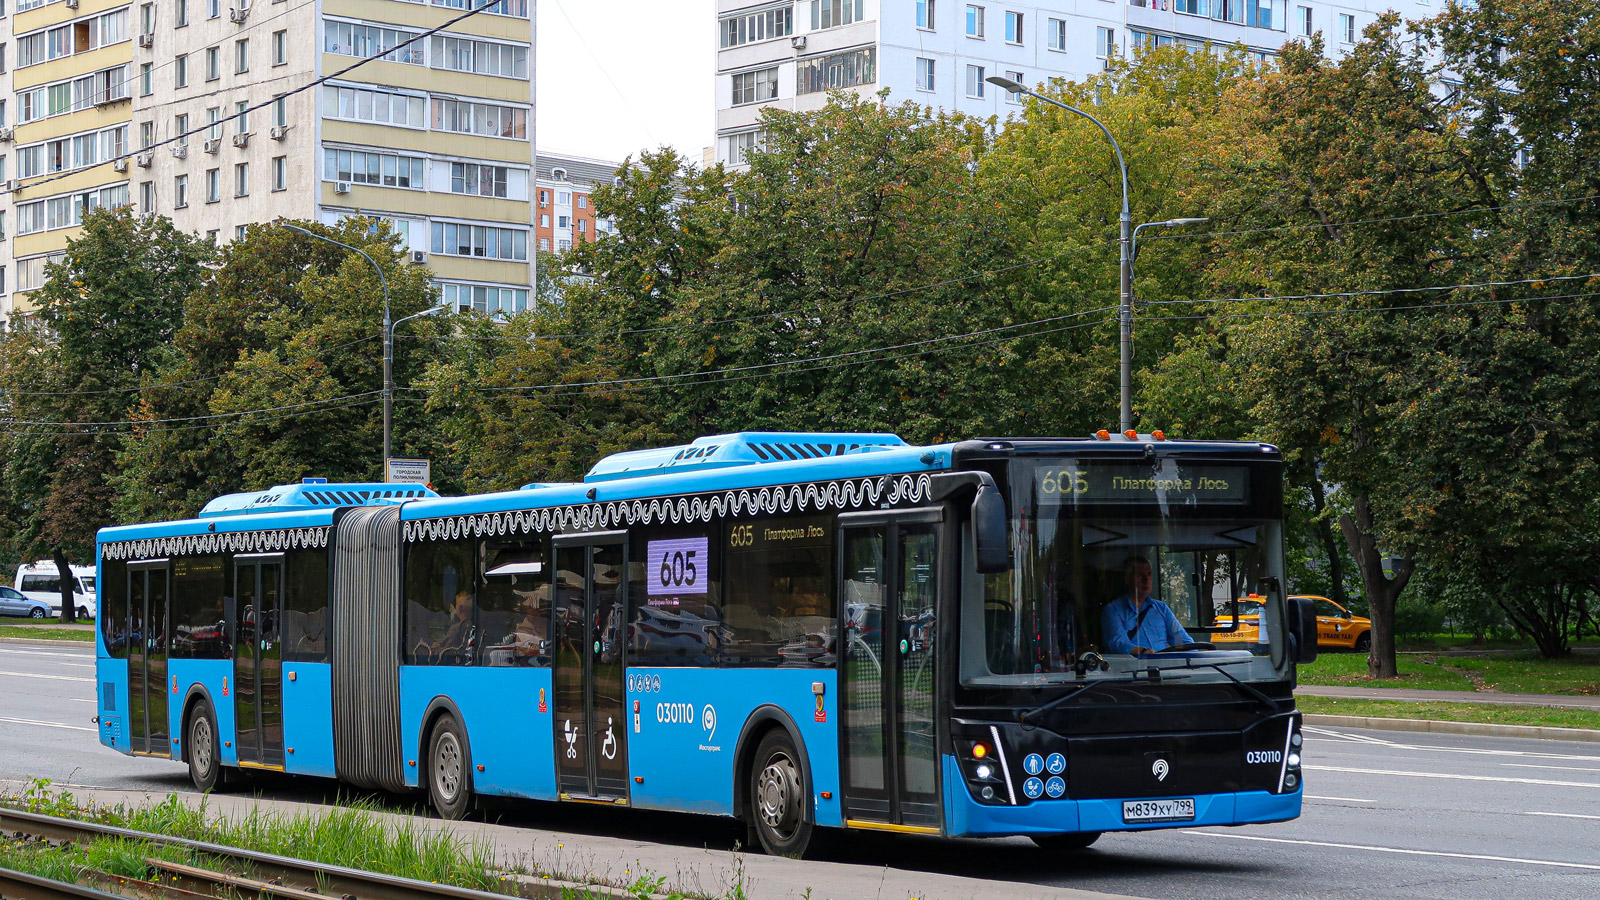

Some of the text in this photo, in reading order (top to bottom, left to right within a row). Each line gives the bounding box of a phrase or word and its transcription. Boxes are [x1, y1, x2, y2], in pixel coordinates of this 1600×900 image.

[1041, 471, 1089, 494] 605
[1112, 476, 1229, 491] Платформа Лось
[730, 525, 753, 547] 605
[764, 525, 825, 541] Платформа Лось
[660, 550, 697, 587] 605
[656, 702, 694, 724] 030110
[1246, 750, 1281, 764] 030110
[1174, 800, 1191, 811] 799
